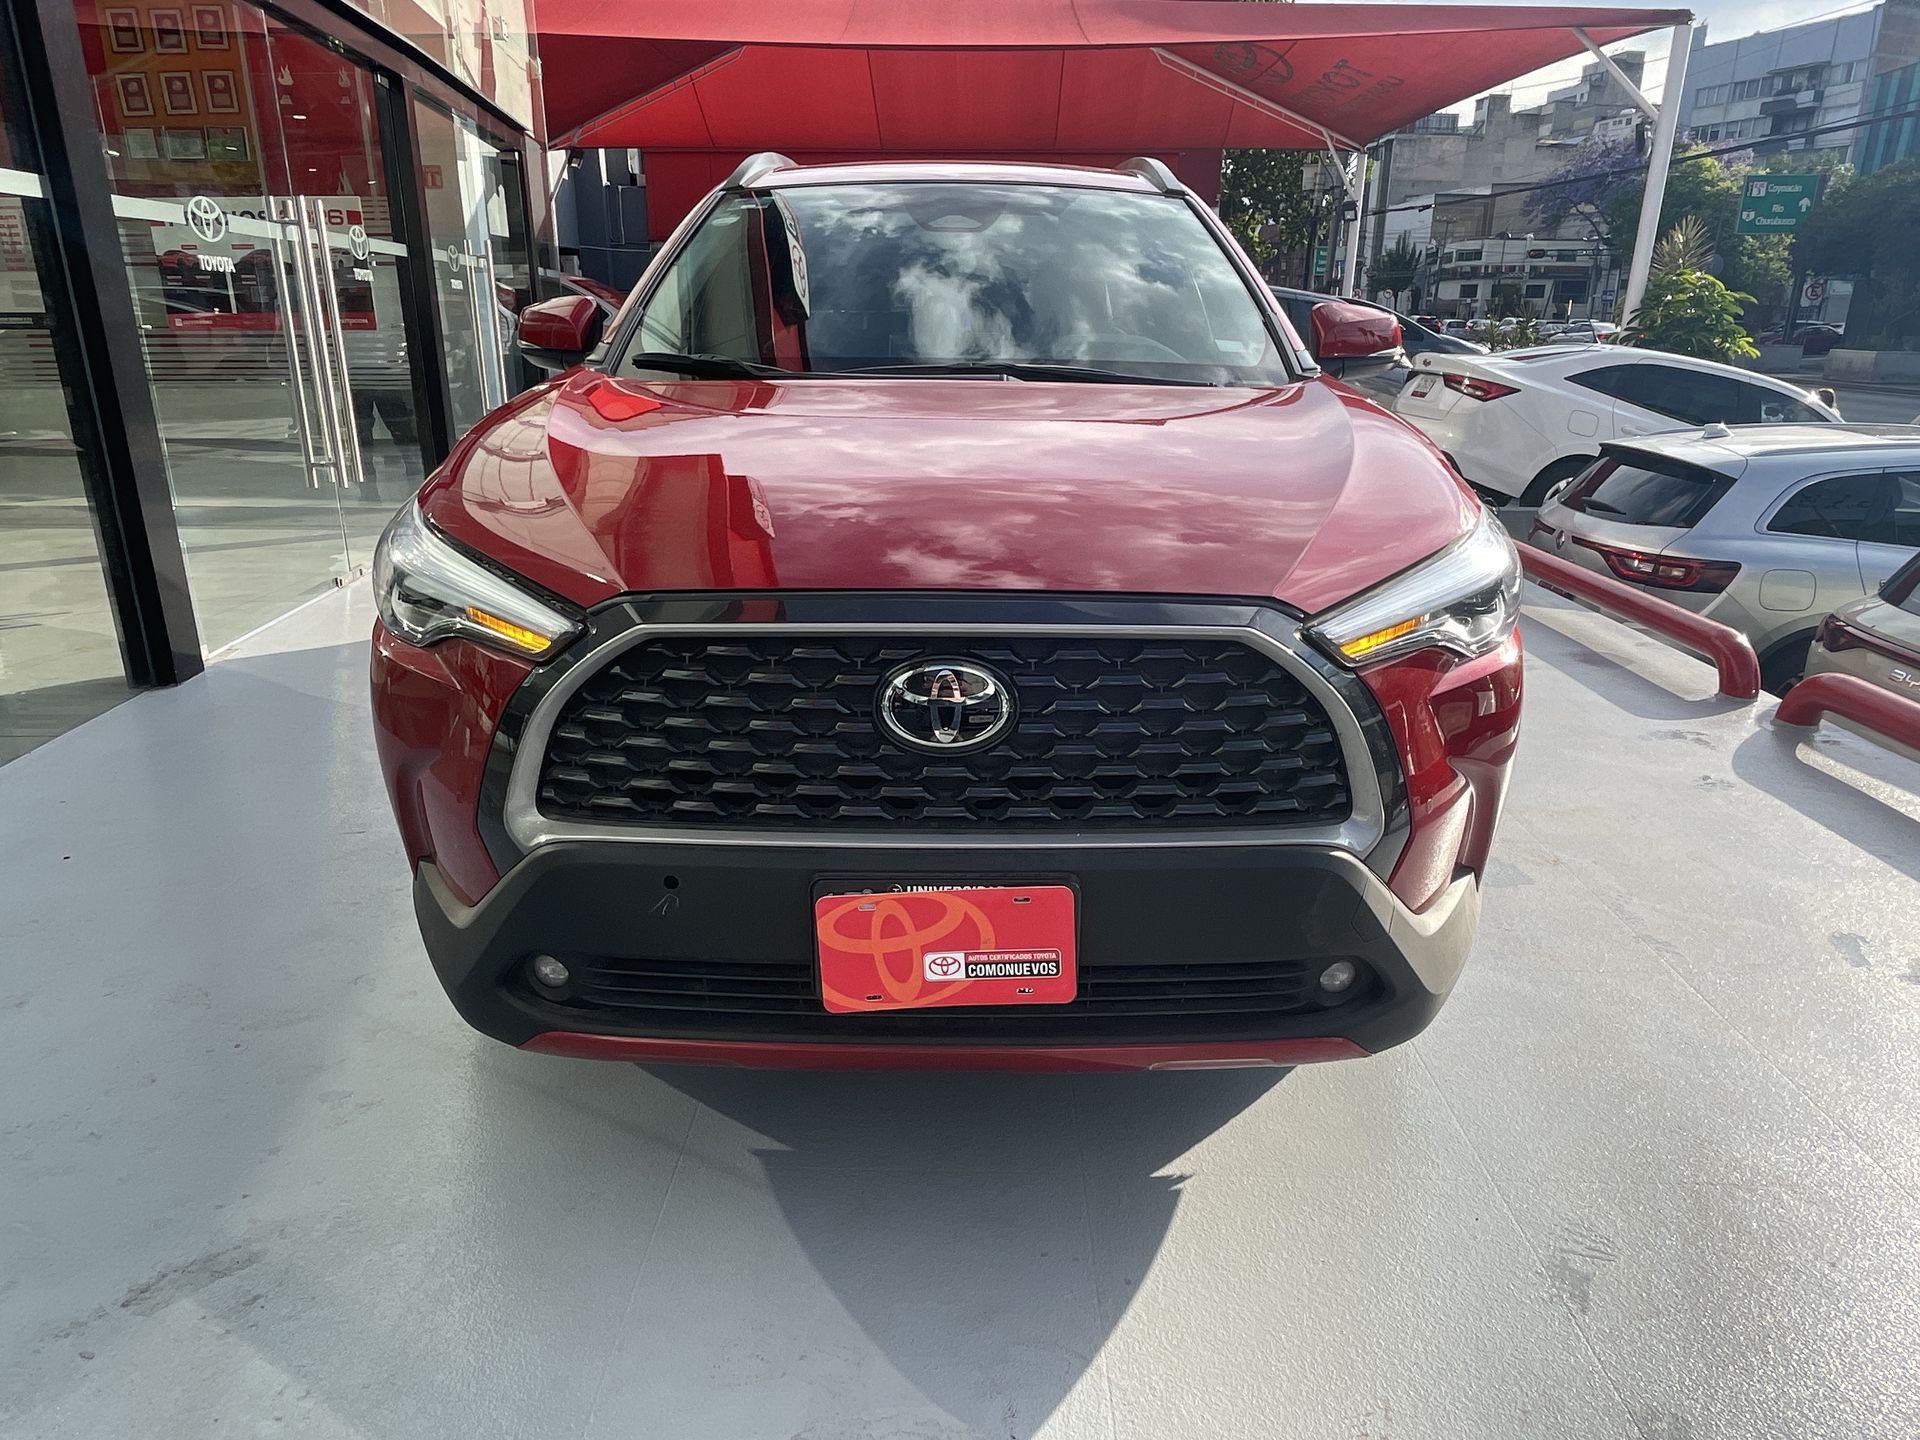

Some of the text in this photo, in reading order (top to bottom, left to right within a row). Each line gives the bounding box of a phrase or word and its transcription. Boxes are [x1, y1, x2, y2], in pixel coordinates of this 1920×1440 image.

[197, 254, 236, 273] TOYOTA
[967, 952, 1057, 962] AUTOS CERTIFICADOS TOYOTA
[967, 962, 1057, 977] COMONUEVOS
